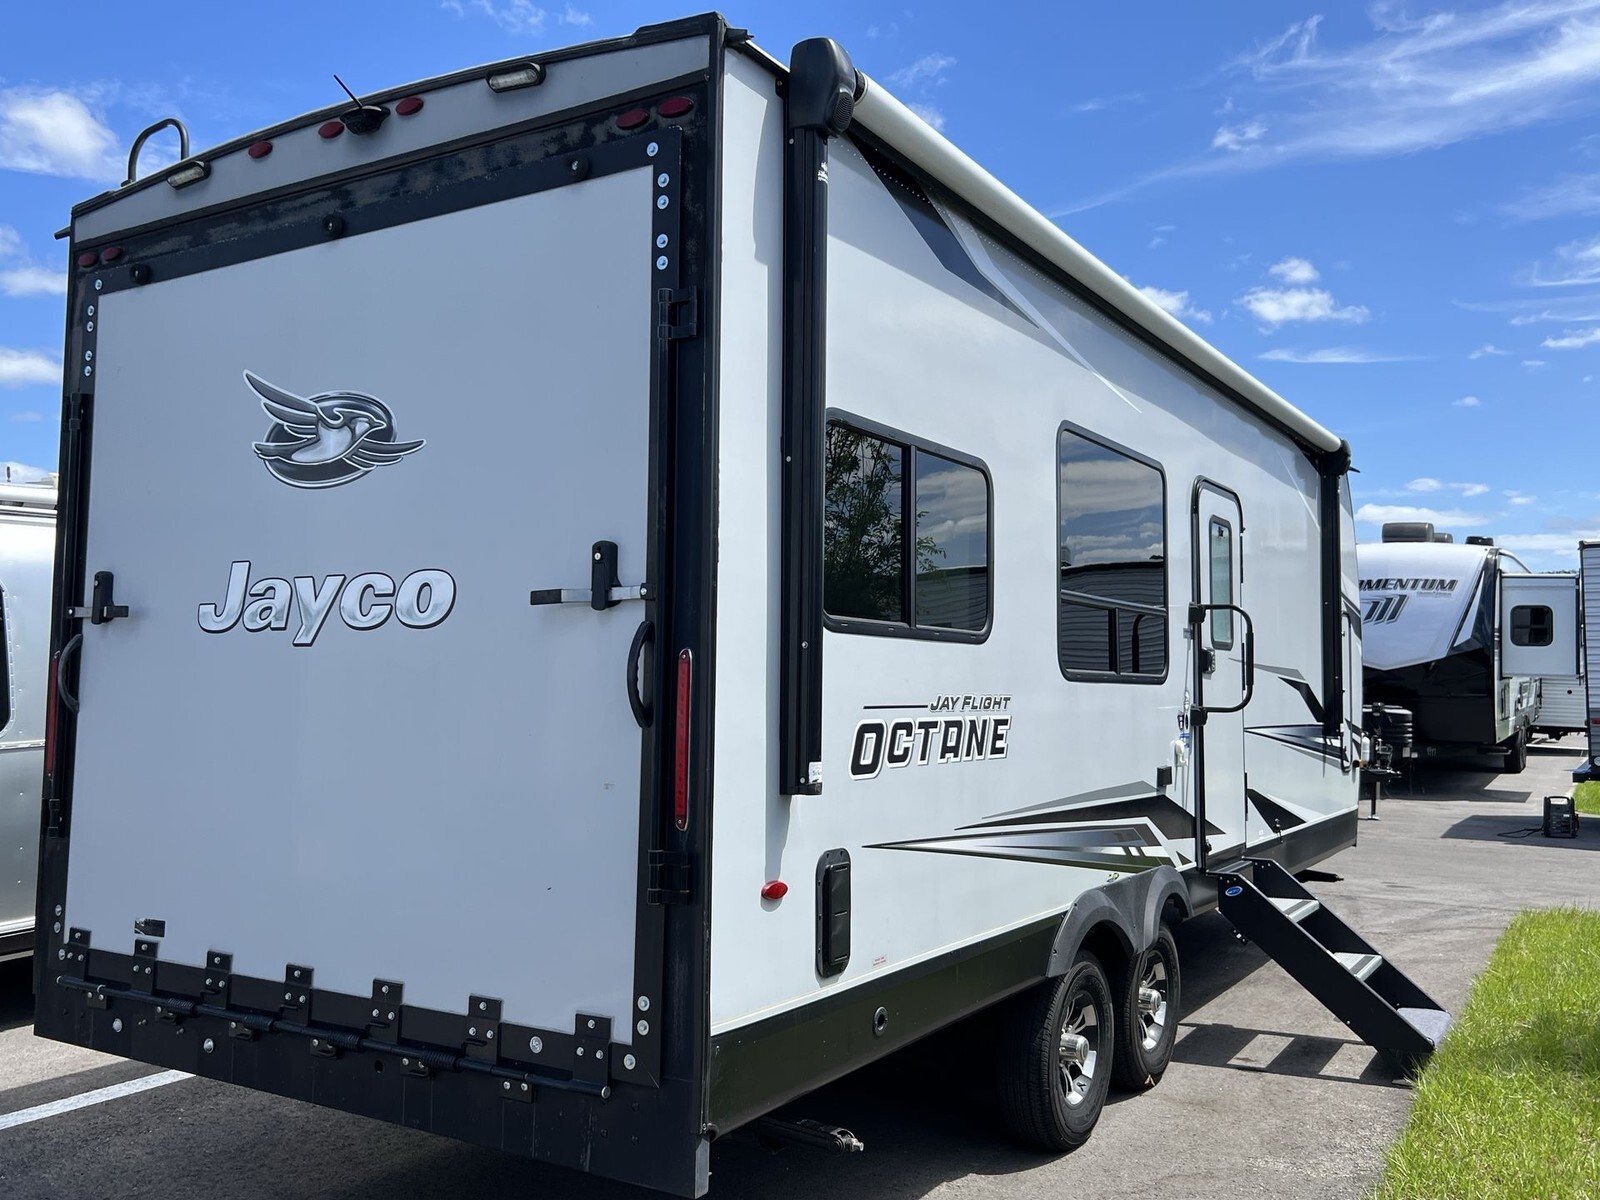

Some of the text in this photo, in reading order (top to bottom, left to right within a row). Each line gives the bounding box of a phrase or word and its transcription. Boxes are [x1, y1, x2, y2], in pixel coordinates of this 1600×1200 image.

[198, 560, 456, 647] Jayco
[930, 694, 1011, 711] JAY FLIGHT
[849, 716, 1011, 780] OCTANE
